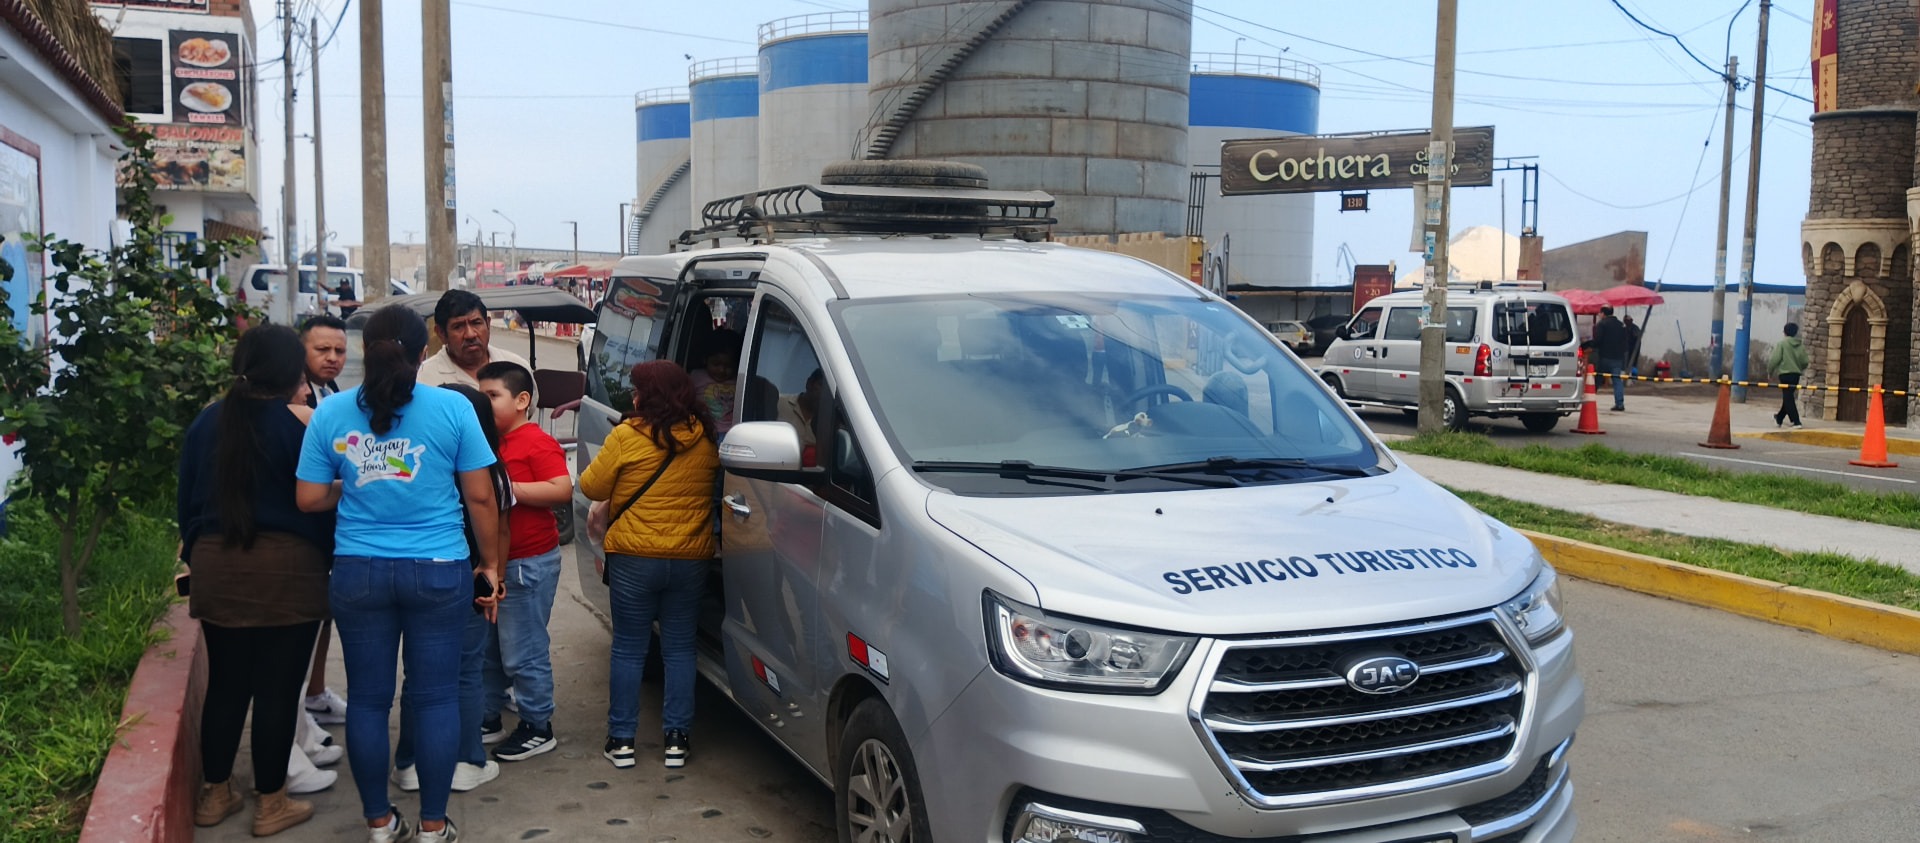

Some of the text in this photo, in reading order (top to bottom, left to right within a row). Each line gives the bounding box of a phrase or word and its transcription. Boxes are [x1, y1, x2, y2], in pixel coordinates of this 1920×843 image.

[156, 126, 242, 141] SALOMÓN
[1249, 147, 1391, 182] Cochera
[1409, 162, 1460, 176] Chaay
[1347, 197, 1363, 208] 1310
[360, 459, 388, 474] Tours
[1162, 547, 1477, 595] SERVICIO TURISTICO
[1362, 663, 1411, 685] JAC
